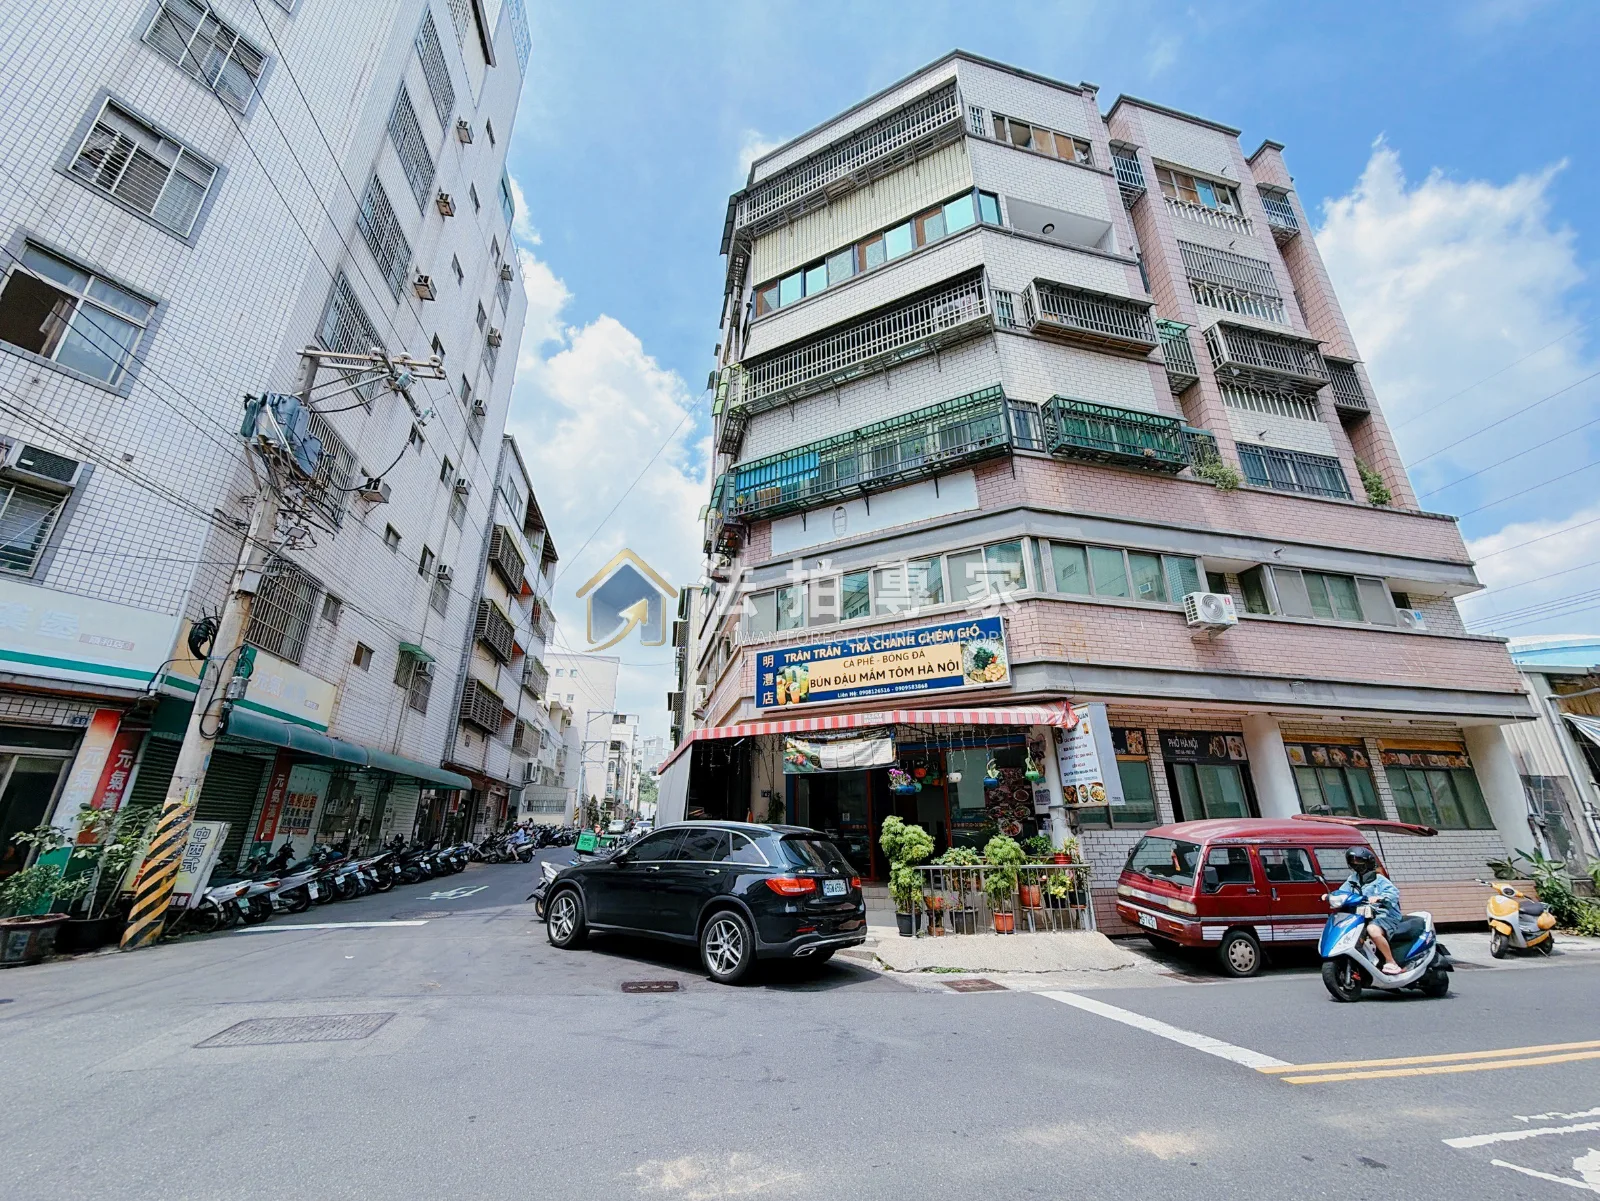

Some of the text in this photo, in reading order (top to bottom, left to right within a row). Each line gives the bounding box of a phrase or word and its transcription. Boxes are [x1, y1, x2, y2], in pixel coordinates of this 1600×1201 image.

[873, 634, 916, 650] CHANH
[918, 628, 954, 644] CHÉM
[956, 622, 980, 638] GIÓ
[882, 650, 910, 663] BÓNG
[911, 649, 926, 660] ĐÁ
[810, 673, 831, 688] BÚN
[833, 670, 856, 687] ĐẬU
[859, 667, 886, 683] MẮM
[917, 661, 935, 676] HÀ
[937, 659, 960, 674] NỘI
[179, 826, 211, 874] 中西式
